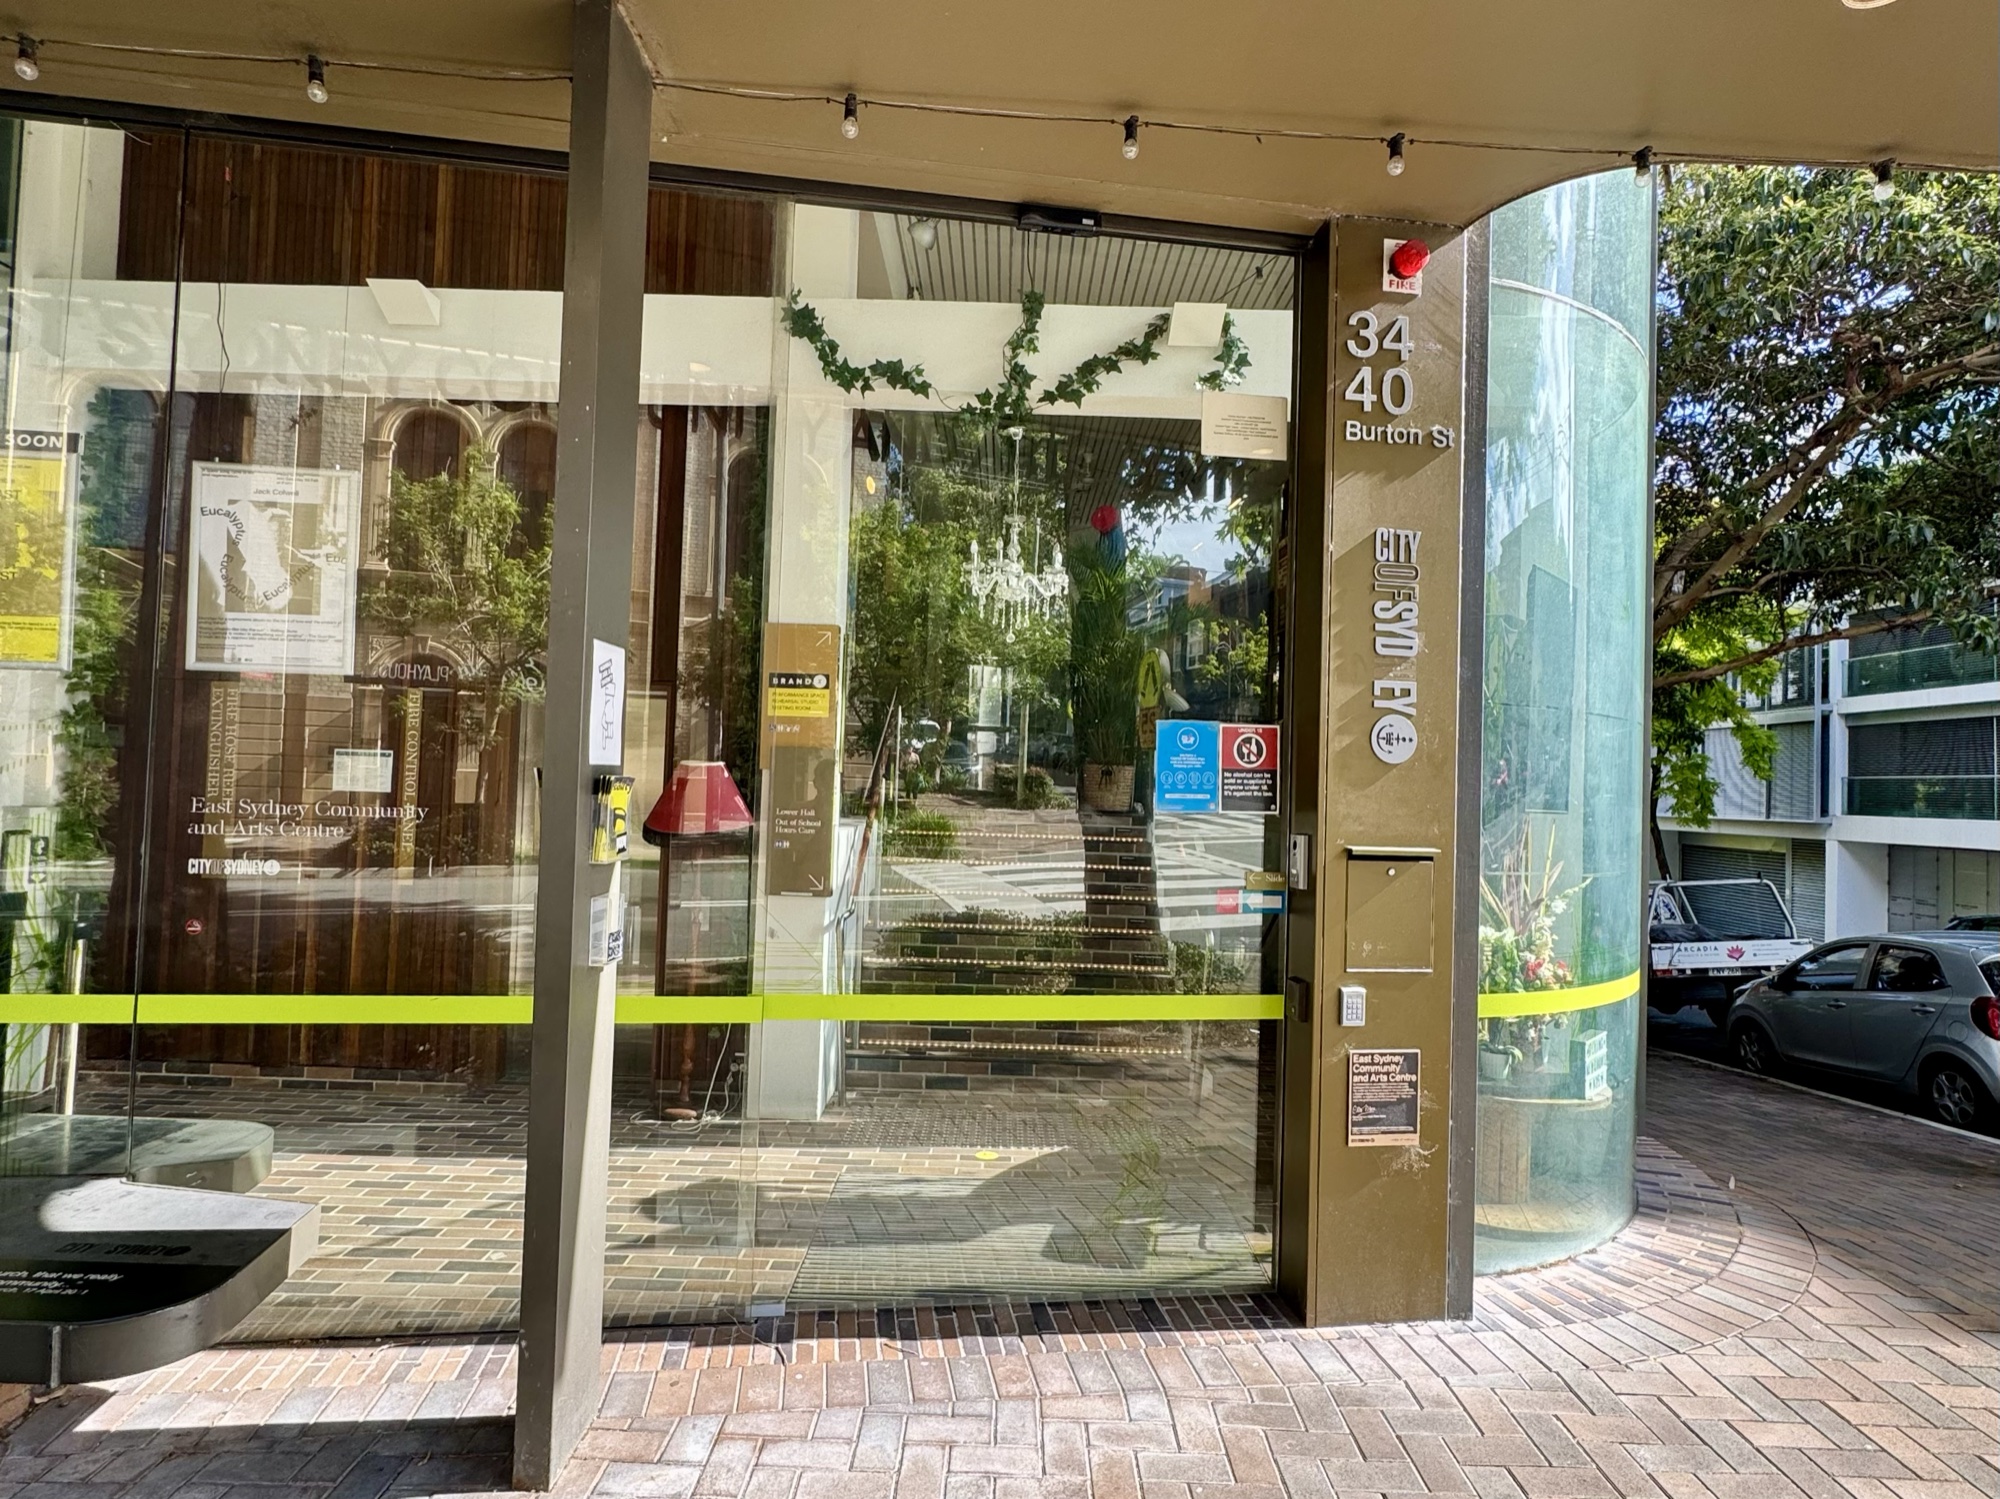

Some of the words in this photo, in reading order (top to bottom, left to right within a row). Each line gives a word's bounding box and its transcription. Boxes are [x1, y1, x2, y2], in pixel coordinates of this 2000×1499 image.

[1388, 279, 1416, 291] FIRE
[1346, 310, 1415, 361] 34
[1344, 366, 1414, 416] 40
[4, 434, 63, 449] SOON
[1345, 420, 1423, 445] Burton
[1431, 426, 1455, 448] St
[253, 488, 270, 496] Jack
[200, 506, 246, 547] Eucalyptus
[1375, 527, 1422, 563] CITY
[1373, 562, 1420, 601] OF
[772, 677, 812, 685] BRAND
[226, 688, 238, 721] FIRE
[408, 693, 421, 727] FIRE
[207, 687, 224, 798] EXTINGUISHER
[224, 725, 237, 764] HOSE
[404, 730, 419, 800] CONTROL
[190, 796, 233, 814] East
[238, 797, 309, 820] Sydney
[315, 799, 430, 825] Community
[776, 808, 798, 816] Lower
[800, 808, 815, 816] Hall
[187, 820, 225, 836] and
[226, 820, 274, 837] Arts
[279, 821, 344, 838] Centre
[798, 819, 822, 827] School
[798, 826, 815, 834] Care
[187, 859, 212, 875] CITY
[224, 859, 265, 875] SYDNEY
[1353, 1054, 1372, 1063] East
[1373, 1054, 1404, 1065] Sydney
[1353, 1063, 1401, 1074] Community
[1353, 1073, 1369, 1082] and
[1370, 1073, 1388, 1082] Arts
[1389, 1073, 1417, 1082] Centre
